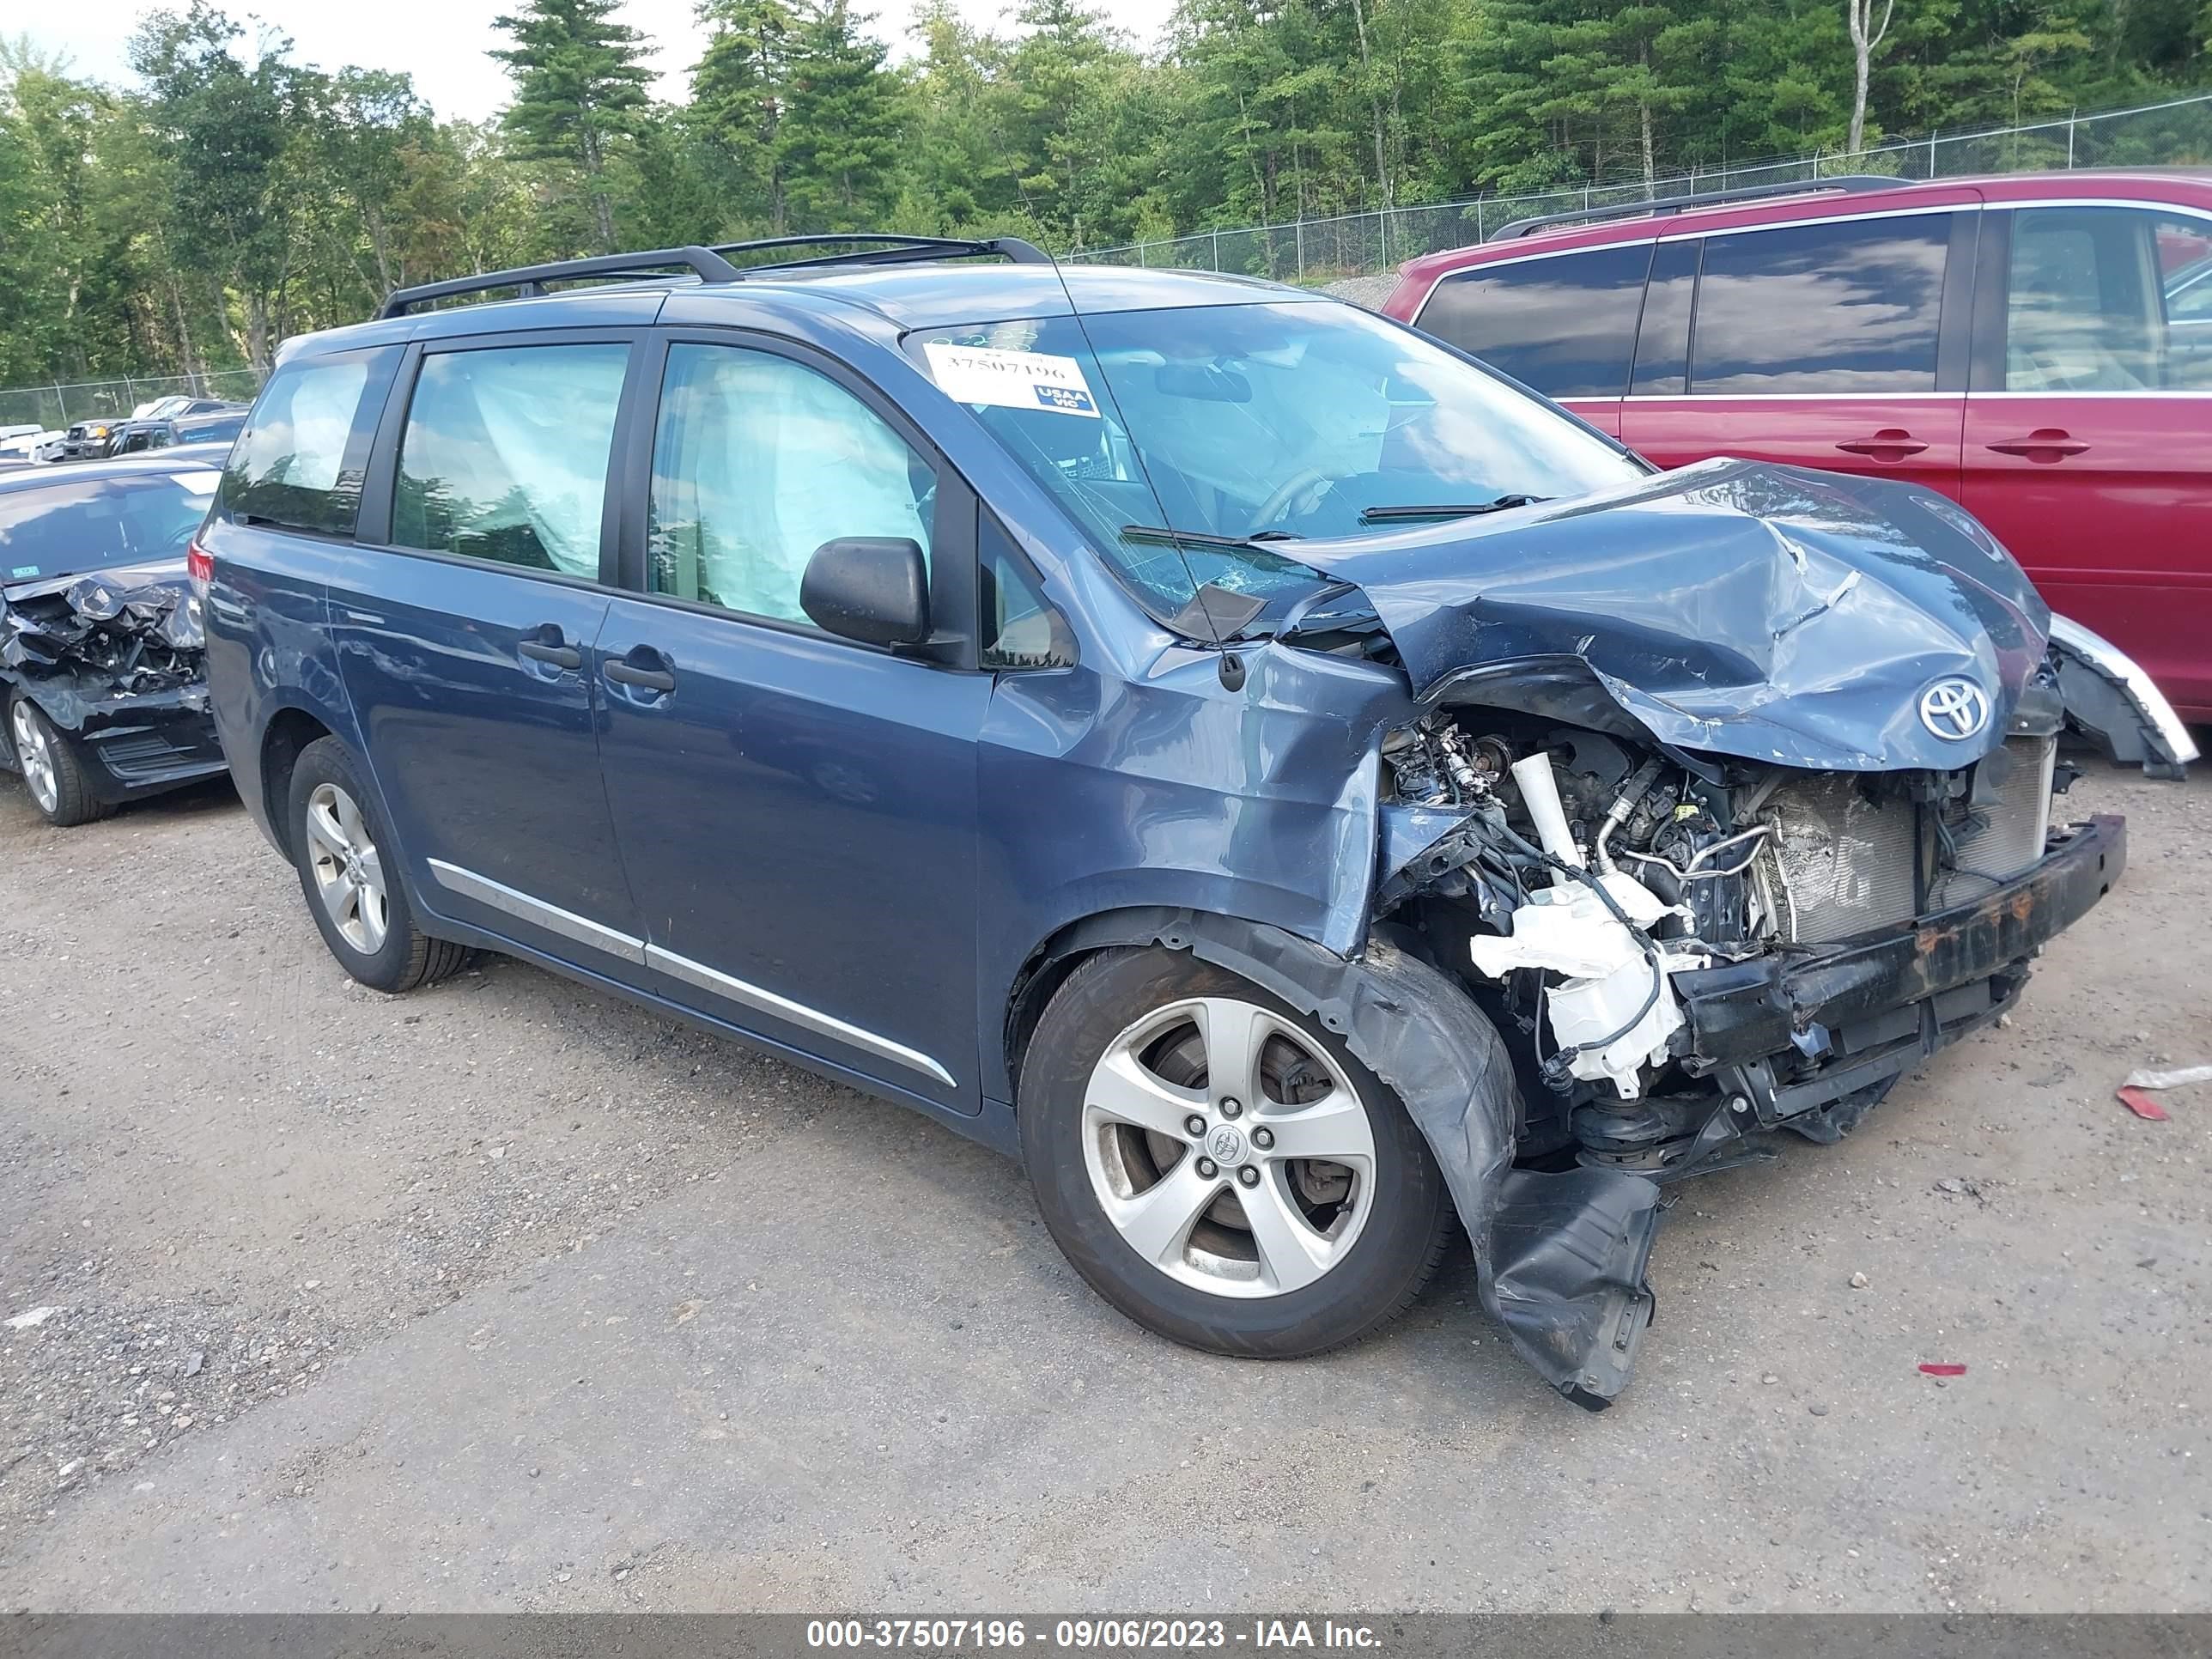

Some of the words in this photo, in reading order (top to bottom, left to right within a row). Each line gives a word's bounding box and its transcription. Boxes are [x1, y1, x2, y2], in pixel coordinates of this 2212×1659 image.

[947, 356, 1066, 380] 37507196
[1037, 386, 1088, 403] USAA
[1053, 398, 1079, 409] VIC
